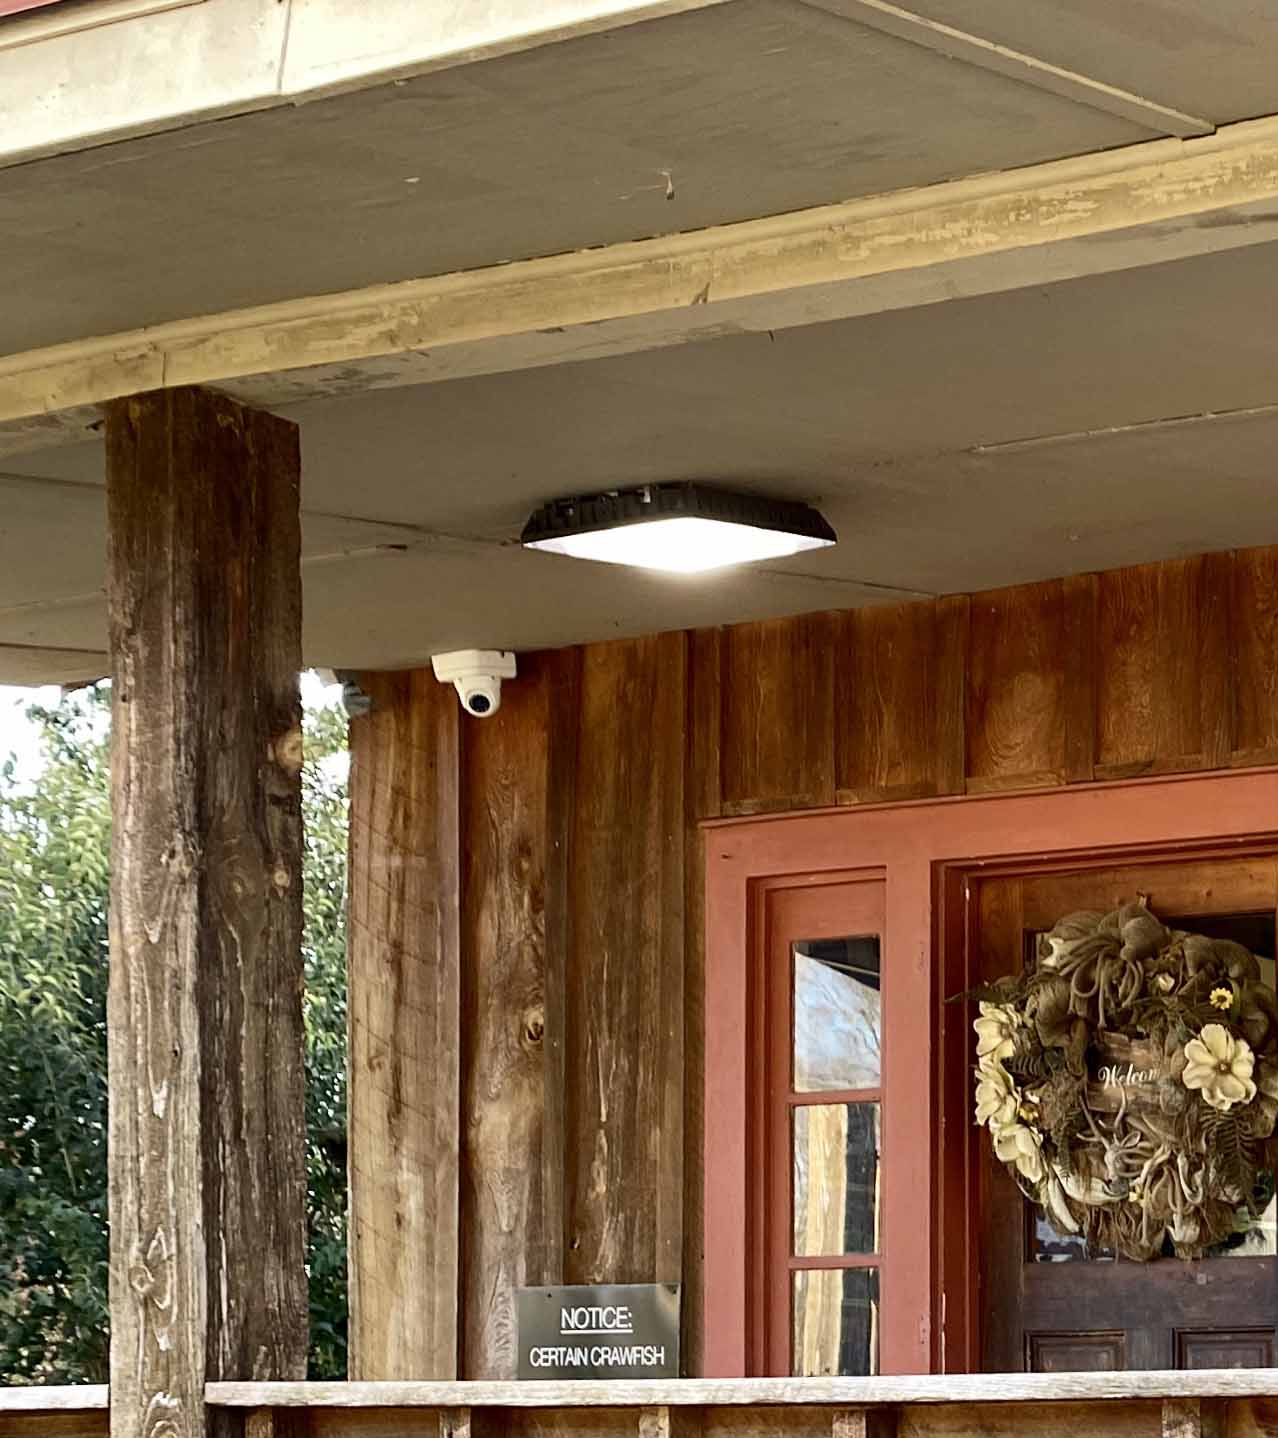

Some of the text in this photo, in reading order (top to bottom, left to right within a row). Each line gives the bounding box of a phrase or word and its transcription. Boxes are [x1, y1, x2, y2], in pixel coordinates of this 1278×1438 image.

[1097, 1063, 1160, 1090] Welcom
[560, 1306, 633, 1329] NOTICE:
[529, 1346, 665, 1368] CERTAIN CRAWFISH
